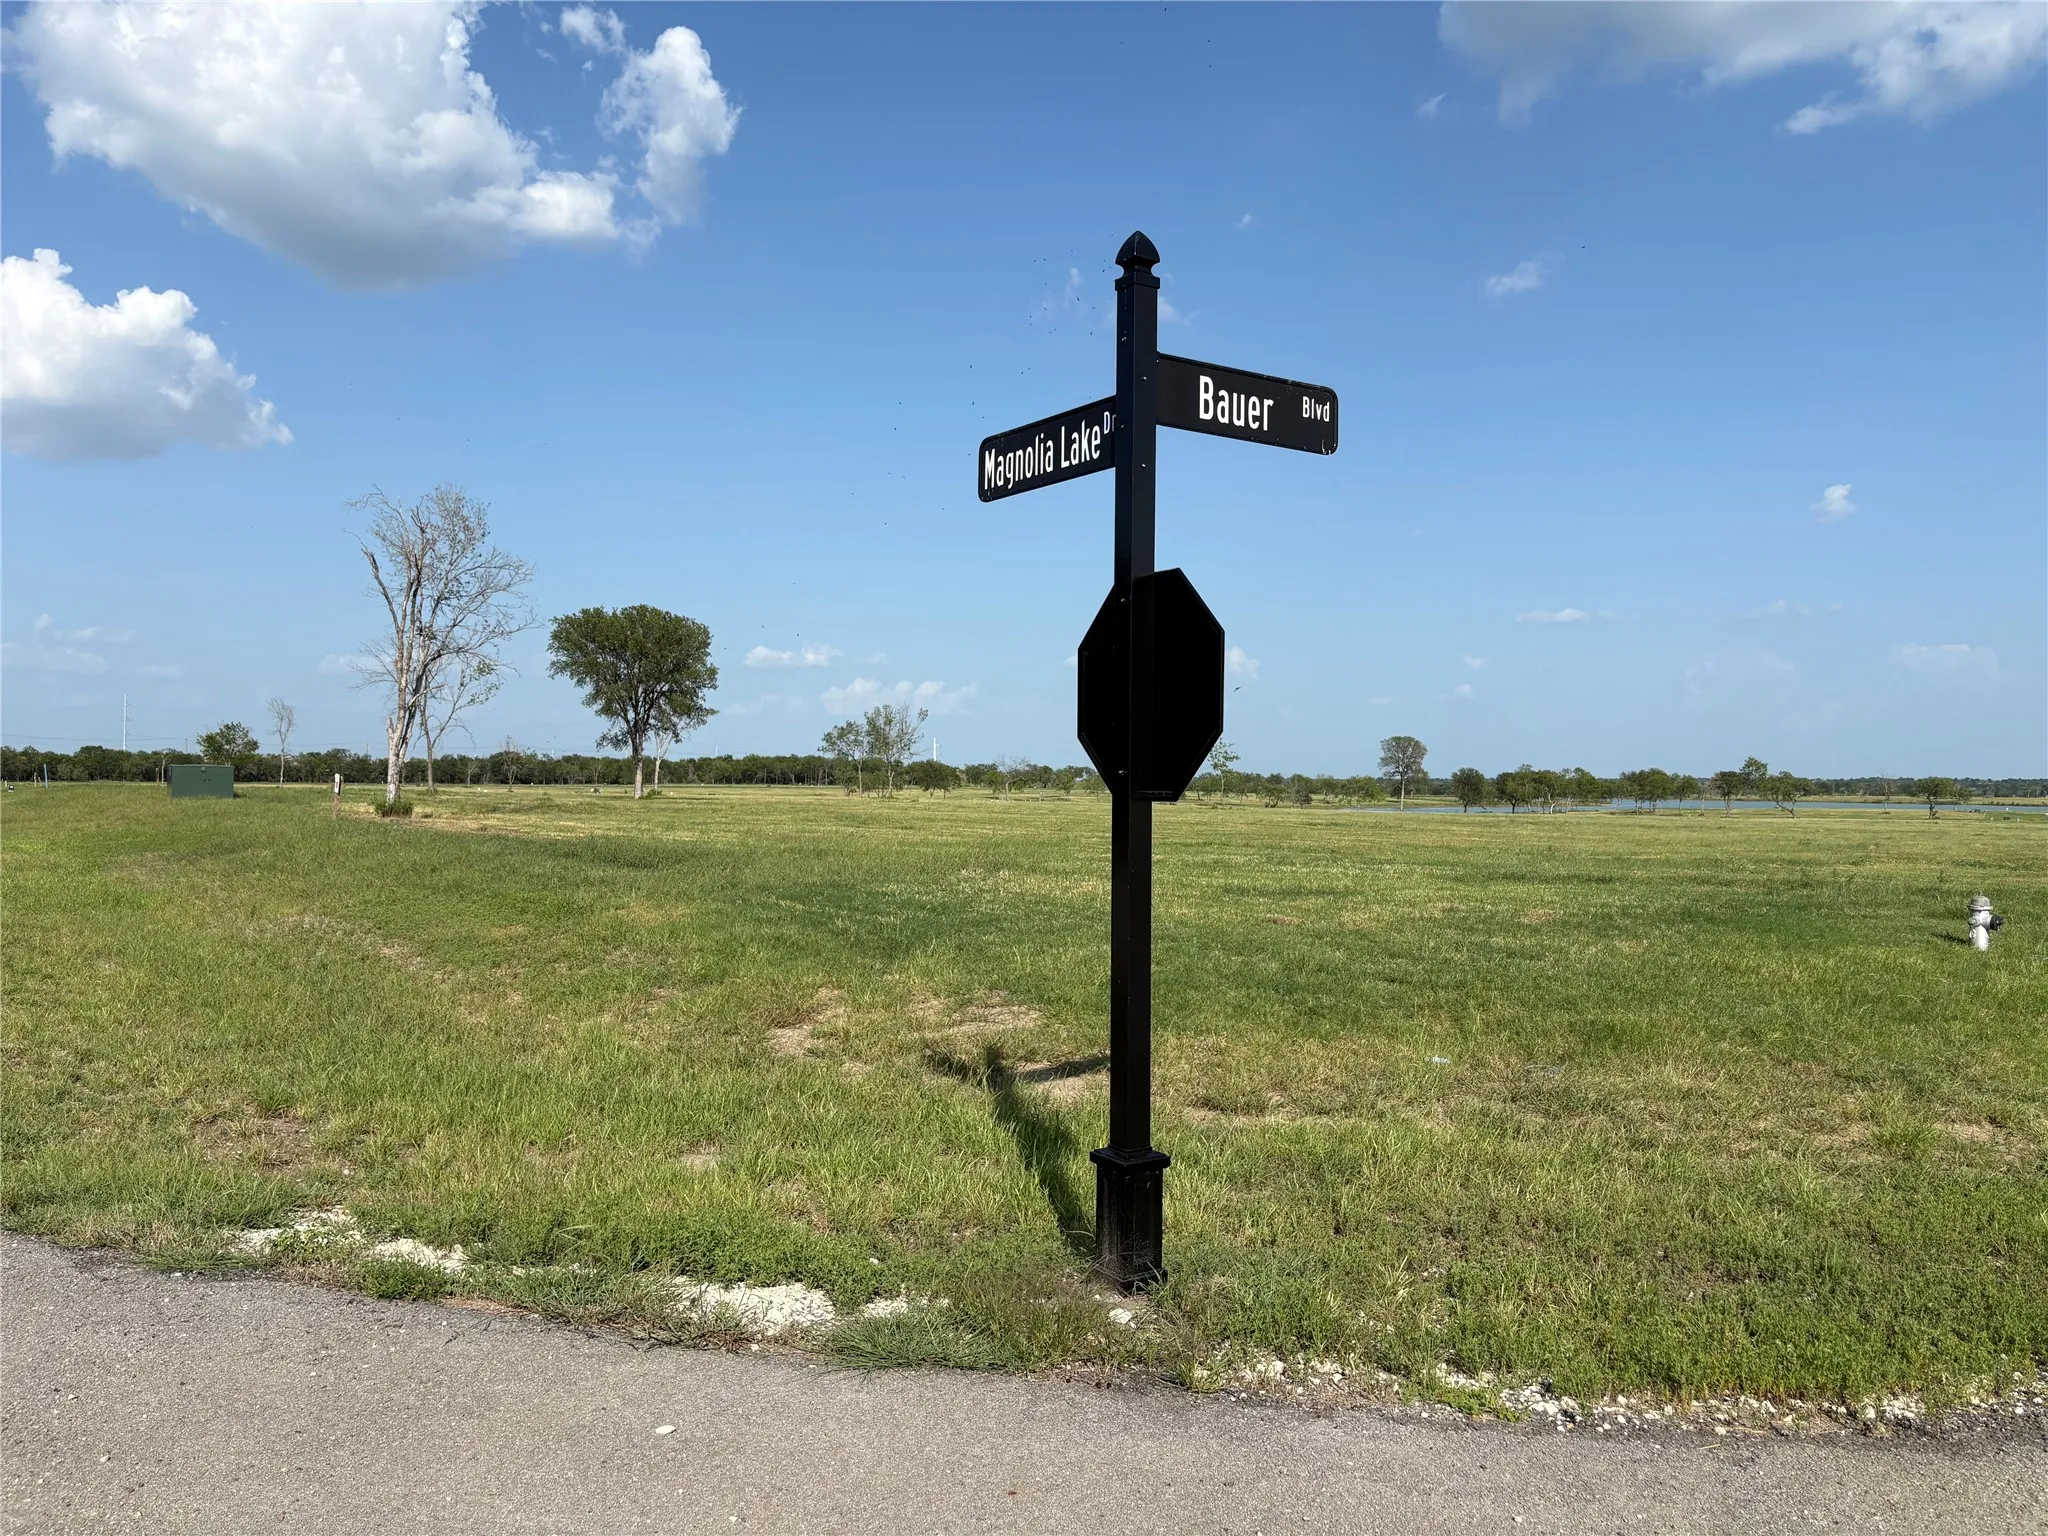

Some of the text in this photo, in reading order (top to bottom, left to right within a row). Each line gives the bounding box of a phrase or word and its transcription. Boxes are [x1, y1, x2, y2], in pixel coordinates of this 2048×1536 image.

[1199, 374, 1330, 432] Bauer Blvd
[984, 411, 1117, 490] Magnolia Lake Dr
